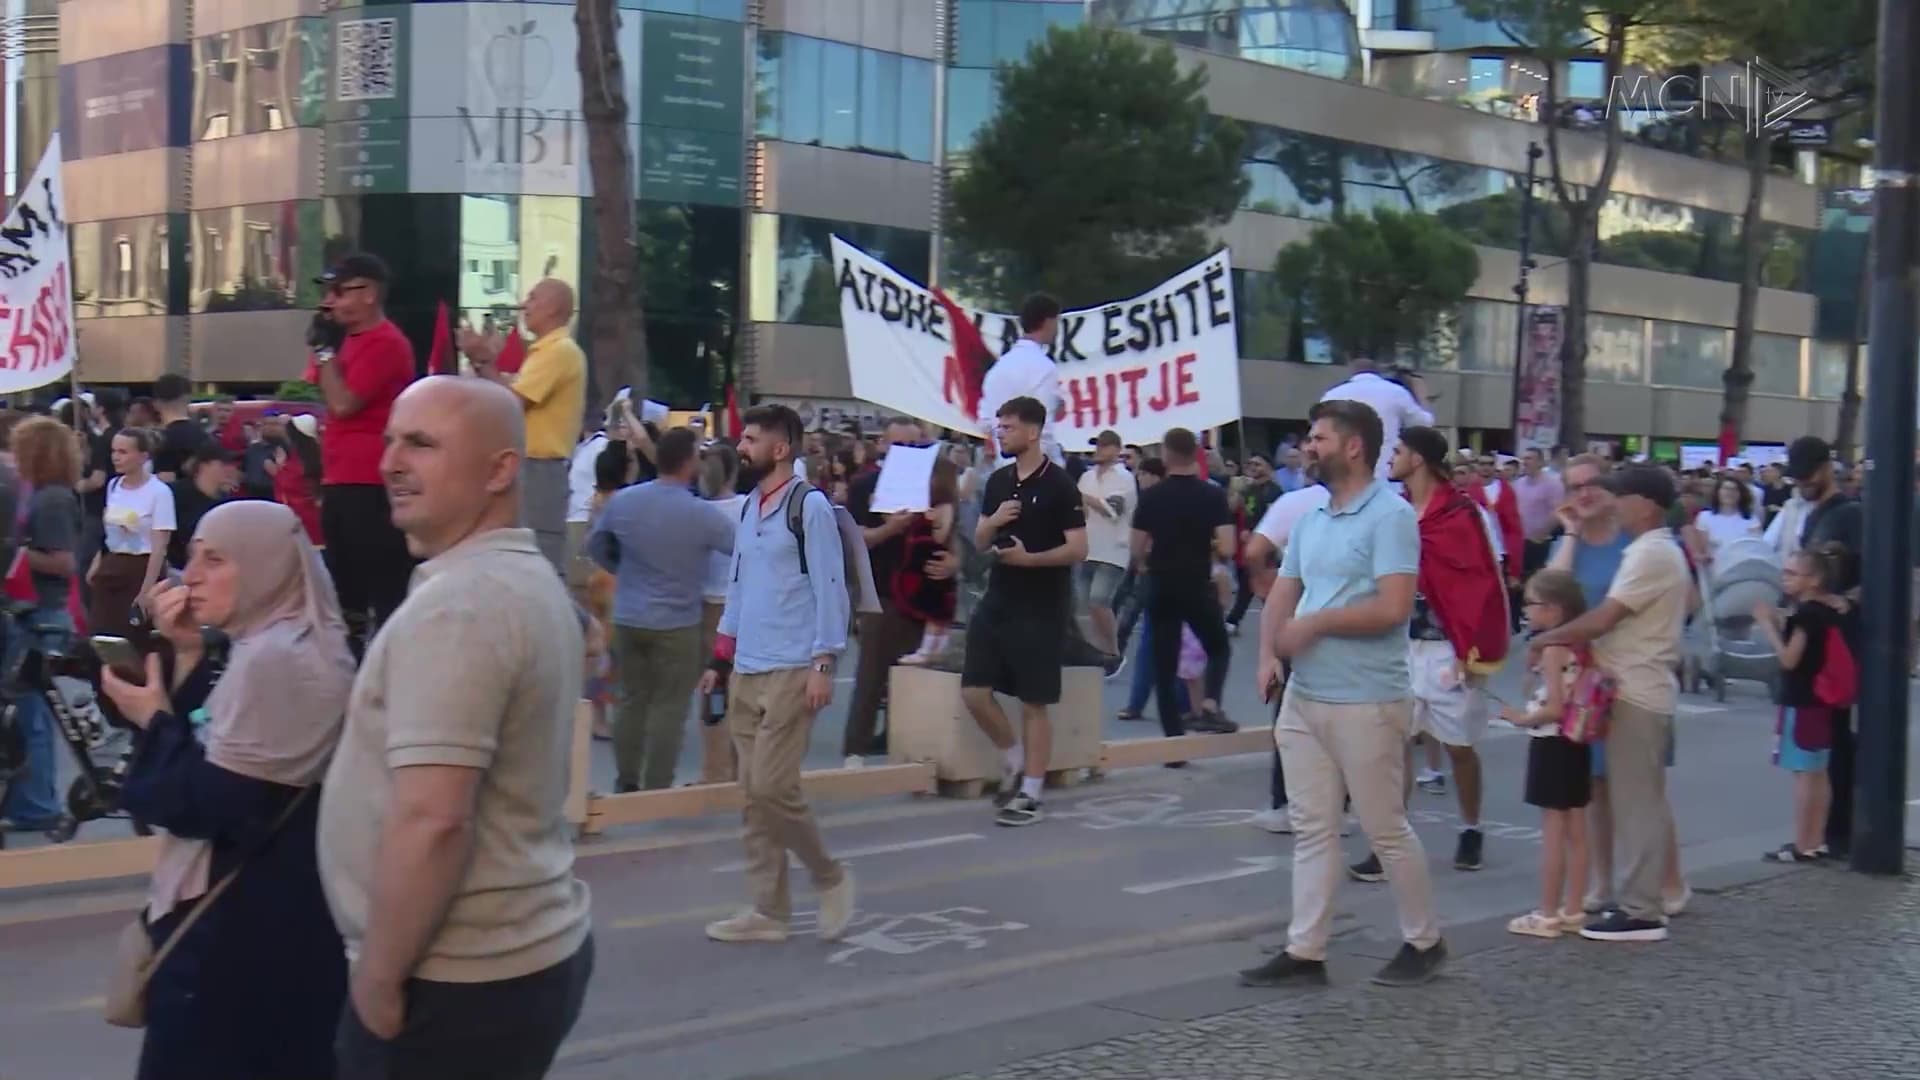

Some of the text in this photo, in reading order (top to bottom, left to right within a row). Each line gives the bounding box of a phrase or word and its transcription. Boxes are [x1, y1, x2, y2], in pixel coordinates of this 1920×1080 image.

[456, 106, 578, 166] MBT
[840, 258, 983, 341] ATDHE
[1104, 261, 1231, 357] ËSHTË
